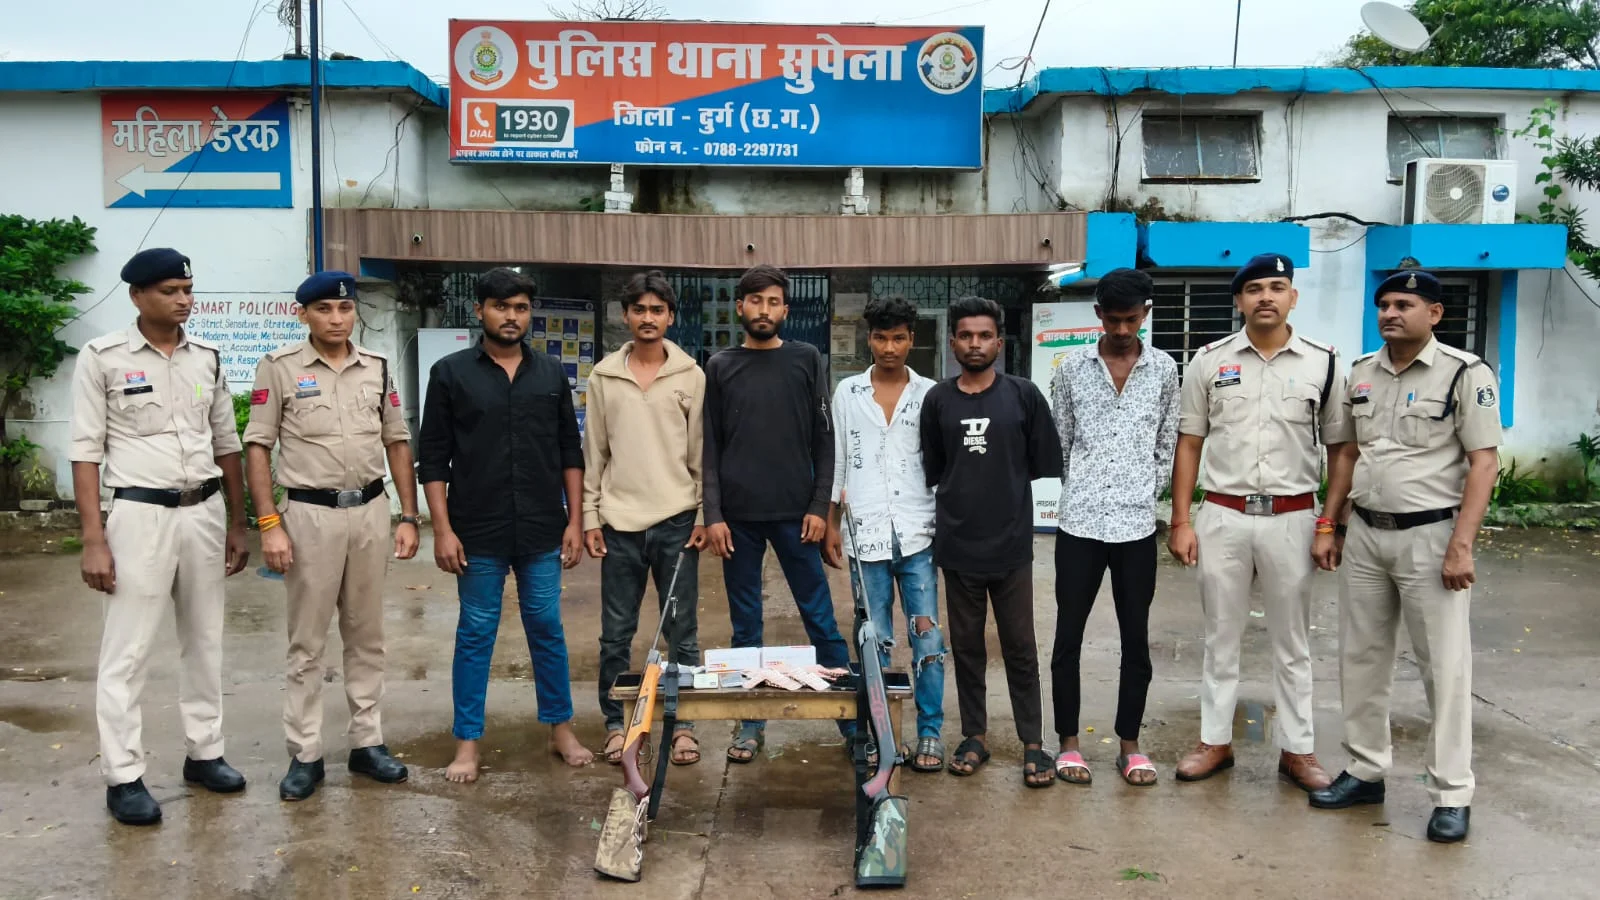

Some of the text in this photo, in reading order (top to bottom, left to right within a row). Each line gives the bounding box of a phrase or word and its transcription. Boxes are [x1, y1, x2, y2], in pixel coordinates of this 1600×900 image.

[526, 30, 907, 94] पुलिस थाना सुपेला
[501, 110, 558, 131] 1930
[613, 101, 675, 126] जिला
[698, 102, 734, 135] दुर्ग
[112, 106, 203, 157] महिला
[469, 129, 494, 138] DIAL
[635, 138, 665, 154] फोन
[704, 142, 798, 157] 0788-2297731
[192, 302, 298, 315] SMART POLICING
[963, 436, 988, 446] DIESEL
